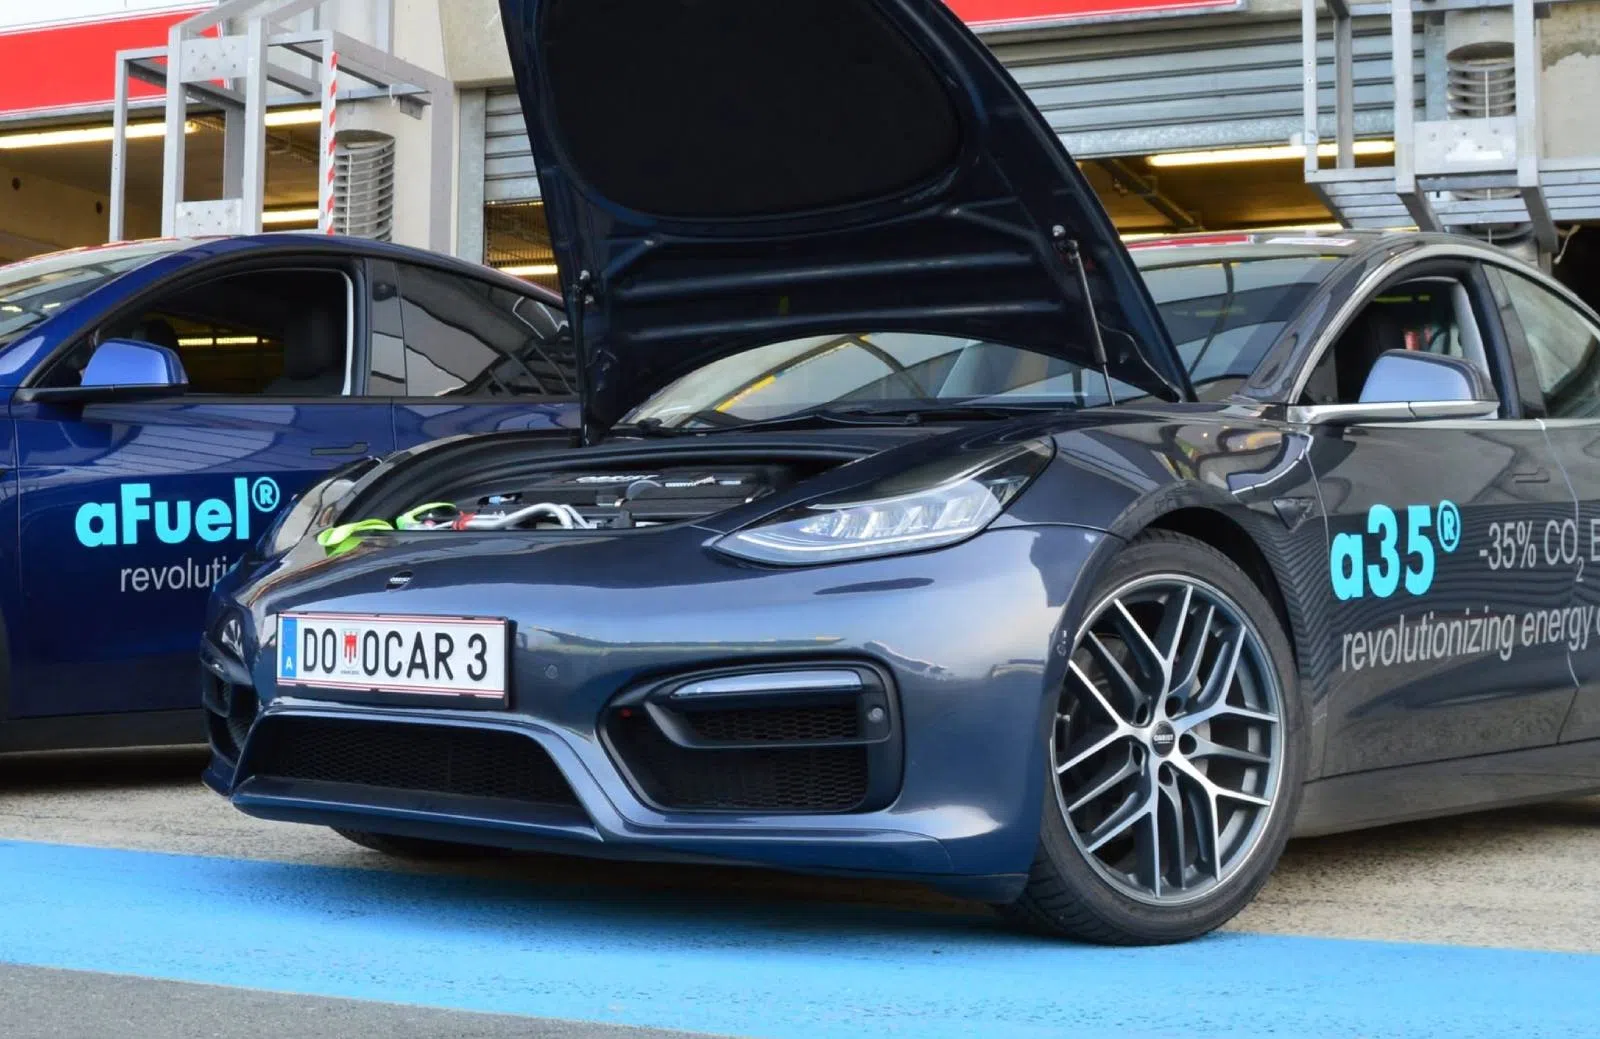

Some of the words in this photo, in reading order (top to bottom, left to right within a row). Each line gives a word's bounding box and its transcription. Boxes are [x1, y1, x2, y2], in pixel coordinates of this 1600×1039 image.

[1479, 521, 1537, 570] -35%
[303, 627, 337, 674] DO
[362, 629, 454, 681] OCAR
[466, 633, 488, 682] 3
[1341, 605, 1516, 673] revolutionizing
[1521, 604, 1594, 652] energy
